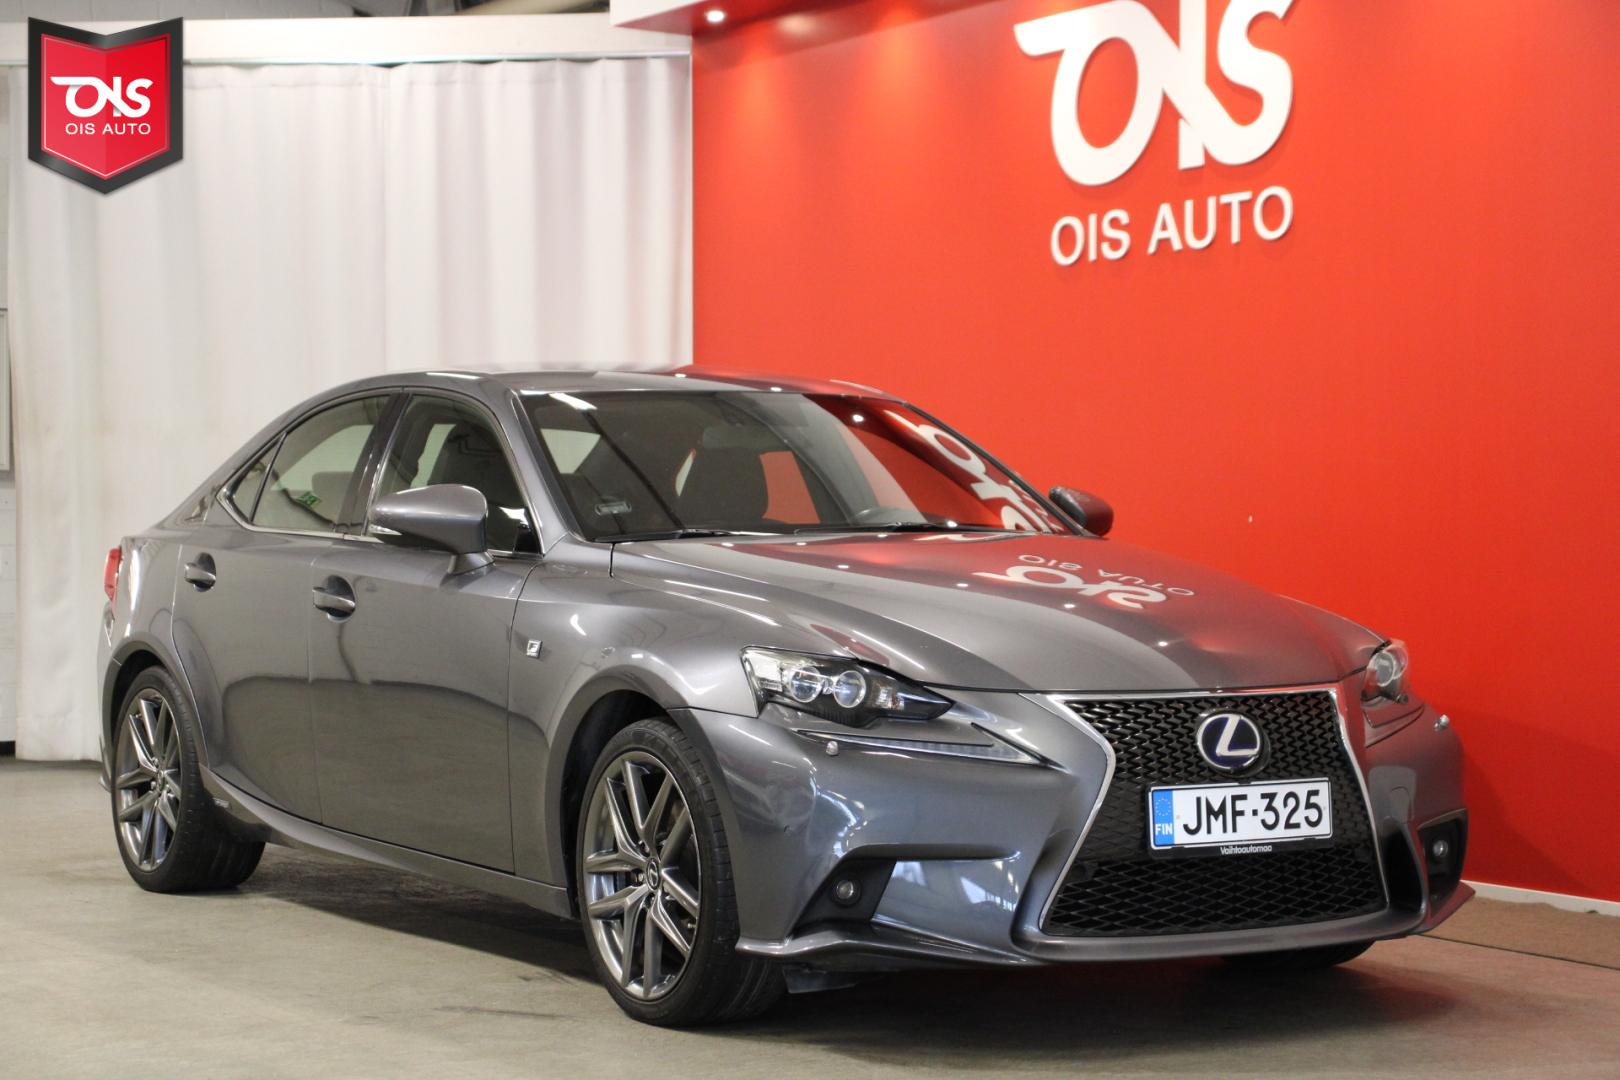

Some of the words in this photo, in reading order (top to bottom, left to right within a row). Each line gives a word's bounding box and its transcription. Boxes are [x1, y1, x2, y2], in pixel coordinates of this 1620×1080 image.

[1051, 209, 1131, 266] OIS
[1147, 186, 1294, 255] AUTO
[1155, 823, 1173, 836] FIN
[1183, 789, 1323, 836] JMF-325
